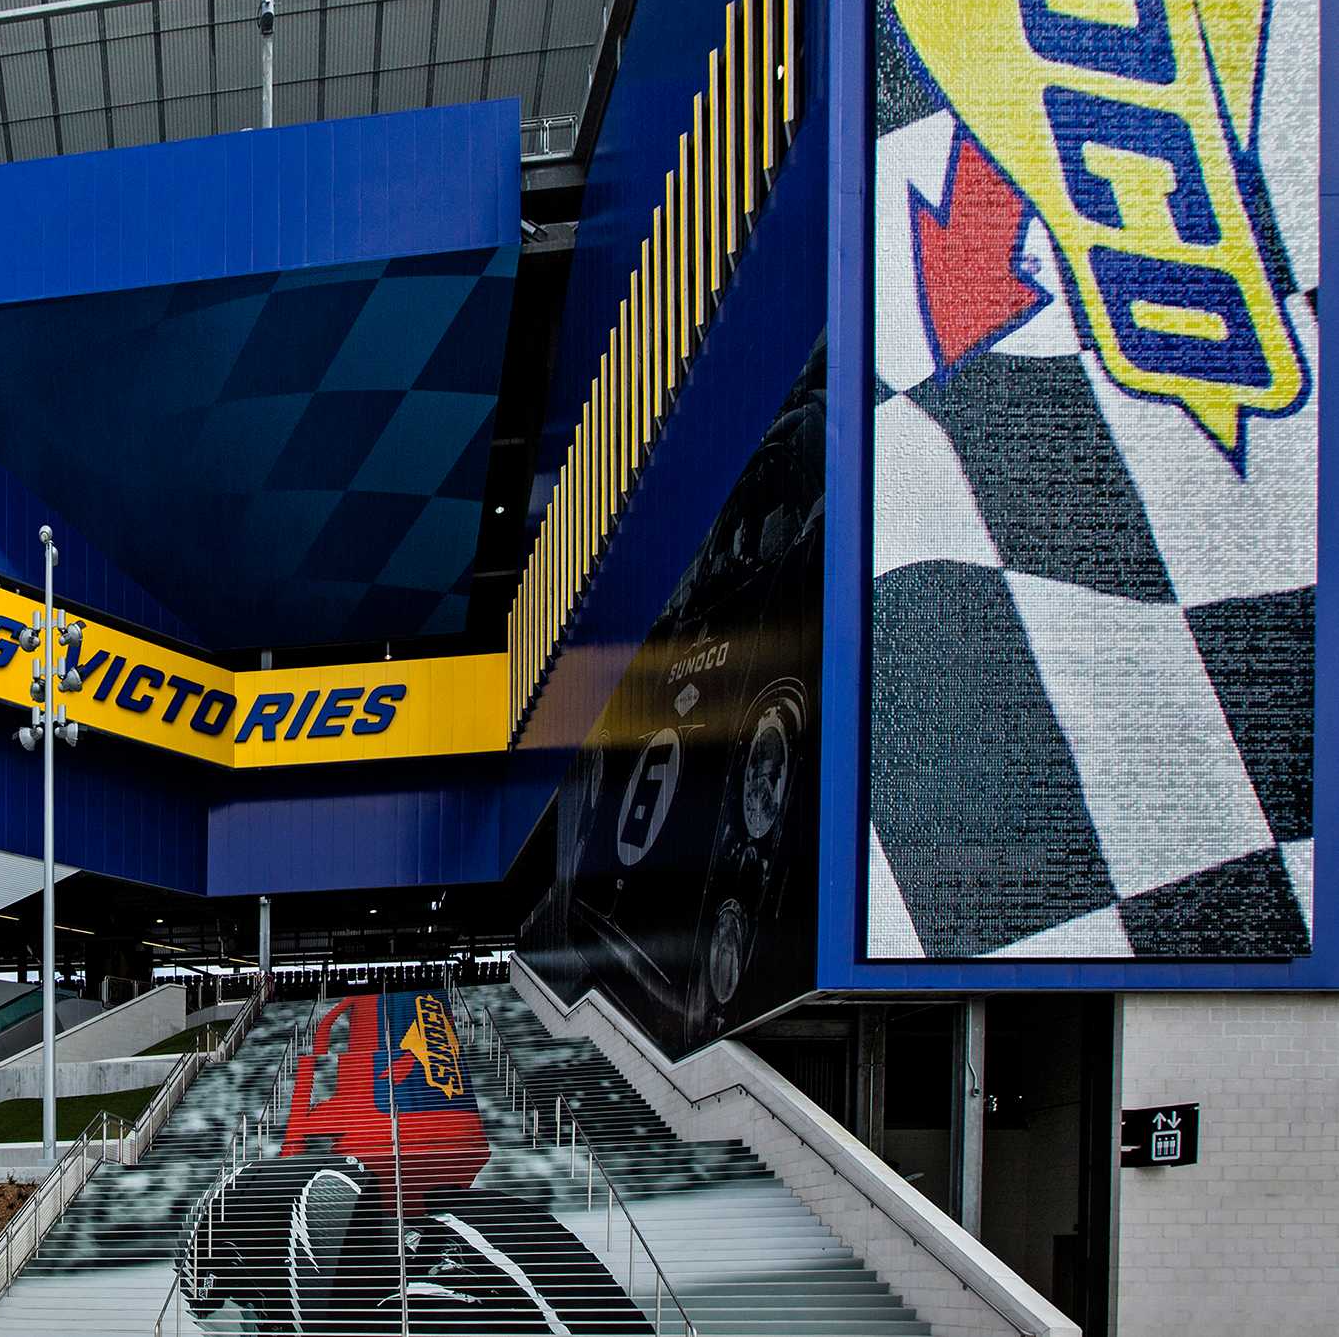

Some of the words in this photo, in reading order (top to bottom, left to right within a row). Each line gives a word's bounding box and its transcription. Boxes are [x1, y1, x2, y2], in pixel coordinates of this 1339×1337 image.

[64, 629, 407, 744] VICTORIES
[667, 642, 730, 684] SUNOCO
[421, 998, 461, 1093] SUNOCO
